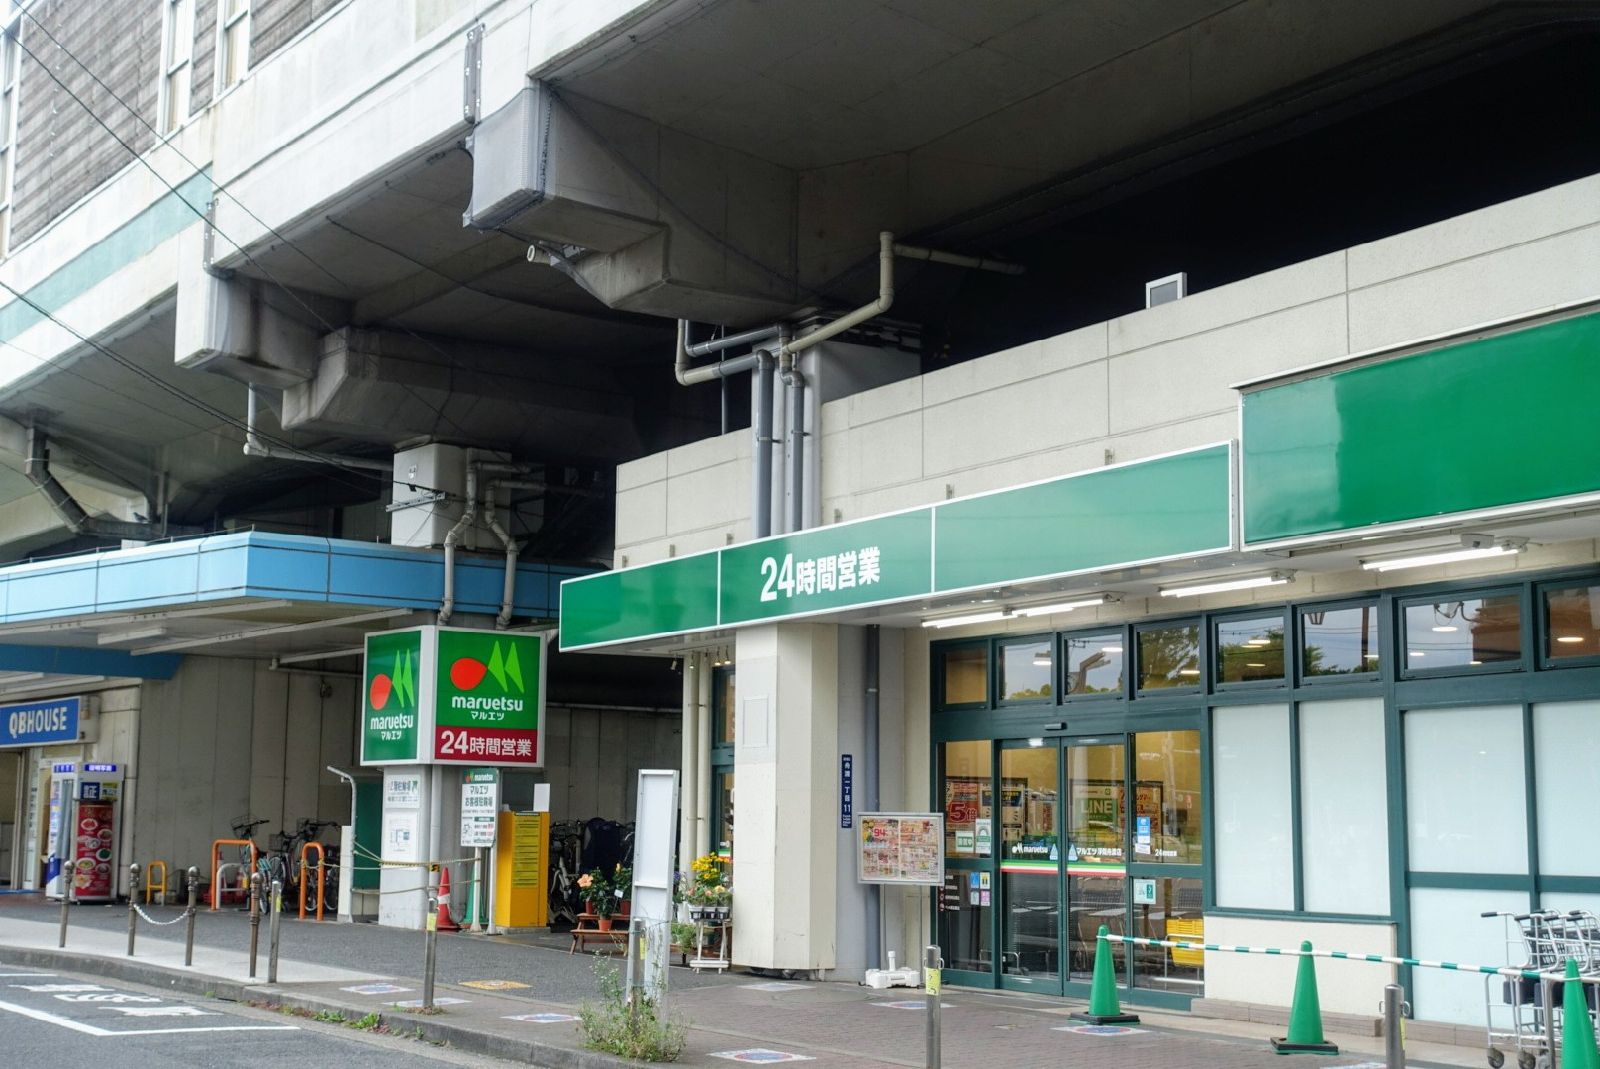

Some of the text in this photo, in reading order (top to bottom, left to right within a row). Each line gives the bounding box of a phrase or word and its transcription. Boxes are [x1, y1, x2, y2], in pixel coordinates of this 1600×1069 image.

[760, 547, 881, 601] 24時間営業
[451, 696, 523, 711] maruetsu
[370, 713, 414, 730] maruetsu
[471, 711, 505, 721] マルエツ
[381, 730, 402, 741] マルエツ
[440, 730, 532, 756] 24時間営業
[470, 786, 488, 794] マルエツ
[1080, 799, 1112, 814] LINE
